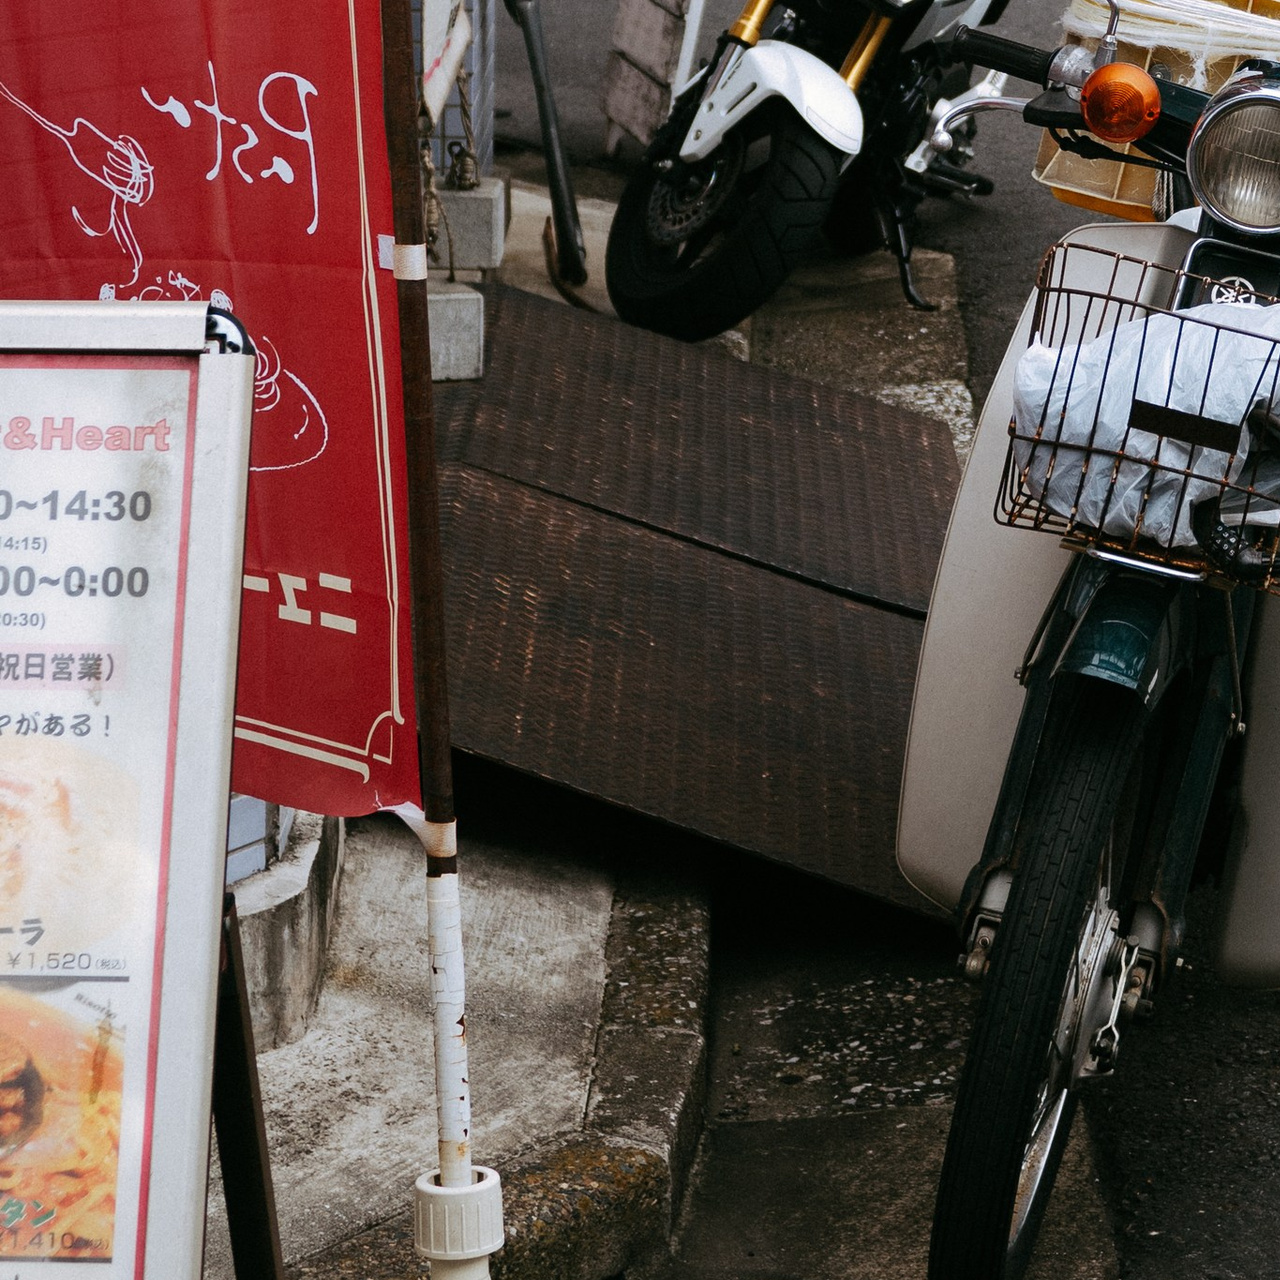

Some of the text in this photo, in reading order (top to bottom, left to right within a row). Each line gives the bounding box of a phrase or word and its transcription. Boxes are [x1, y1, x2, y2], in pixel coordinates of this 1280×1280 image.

[0, 416, 171, 452] &Heart
[0, 536, 47, 554] 4:15)
[0, 612, 46, 630] 0:30)
